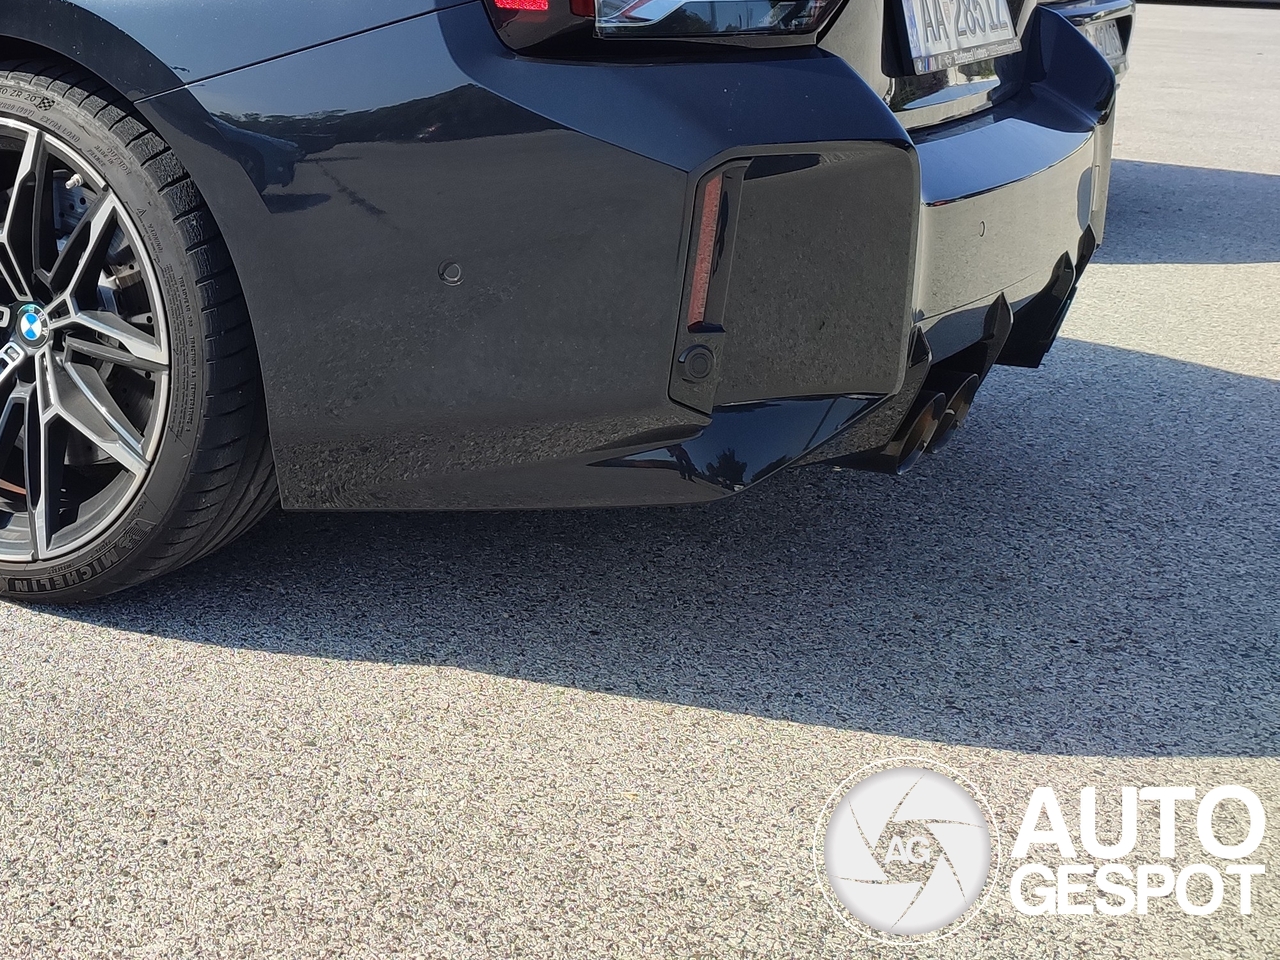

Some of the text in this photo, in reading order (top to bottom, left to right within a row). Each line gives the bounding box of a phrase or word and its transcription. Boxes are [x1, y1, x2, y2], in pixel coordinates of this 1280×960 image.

[10, 89, 23, 99] ZR
[26, 93, 37, 103] 20
[14, 547, 121, 593] MICHELIN
